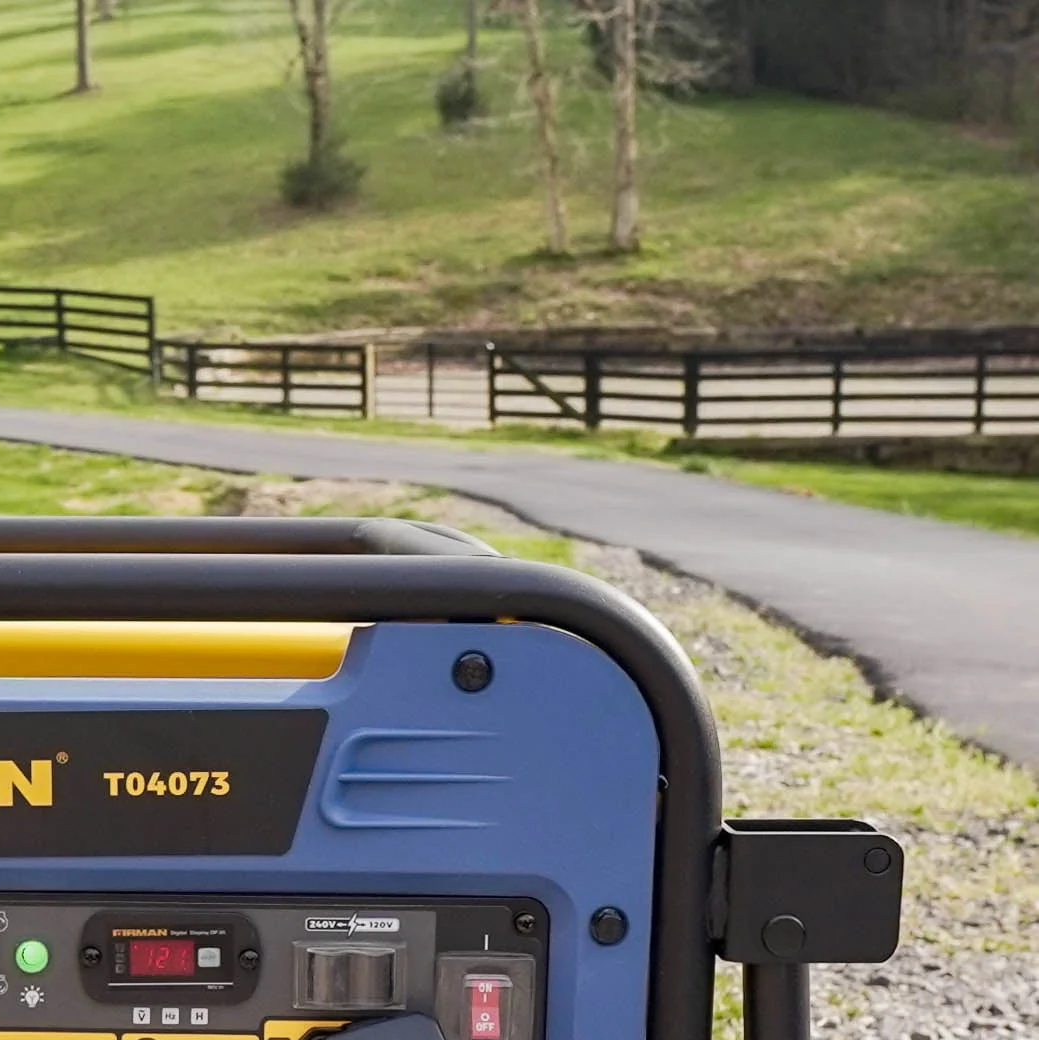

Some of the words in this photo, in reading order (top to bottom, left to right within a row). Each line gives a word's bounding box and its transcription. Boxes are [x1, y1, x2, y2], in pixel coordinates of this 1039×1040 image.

[103, 771, 230, 796] T04073
[478, 984, 493, 993] ON
[196, 1012, 204, 1020] H
[475, 1023, 495, 1032] OFF
